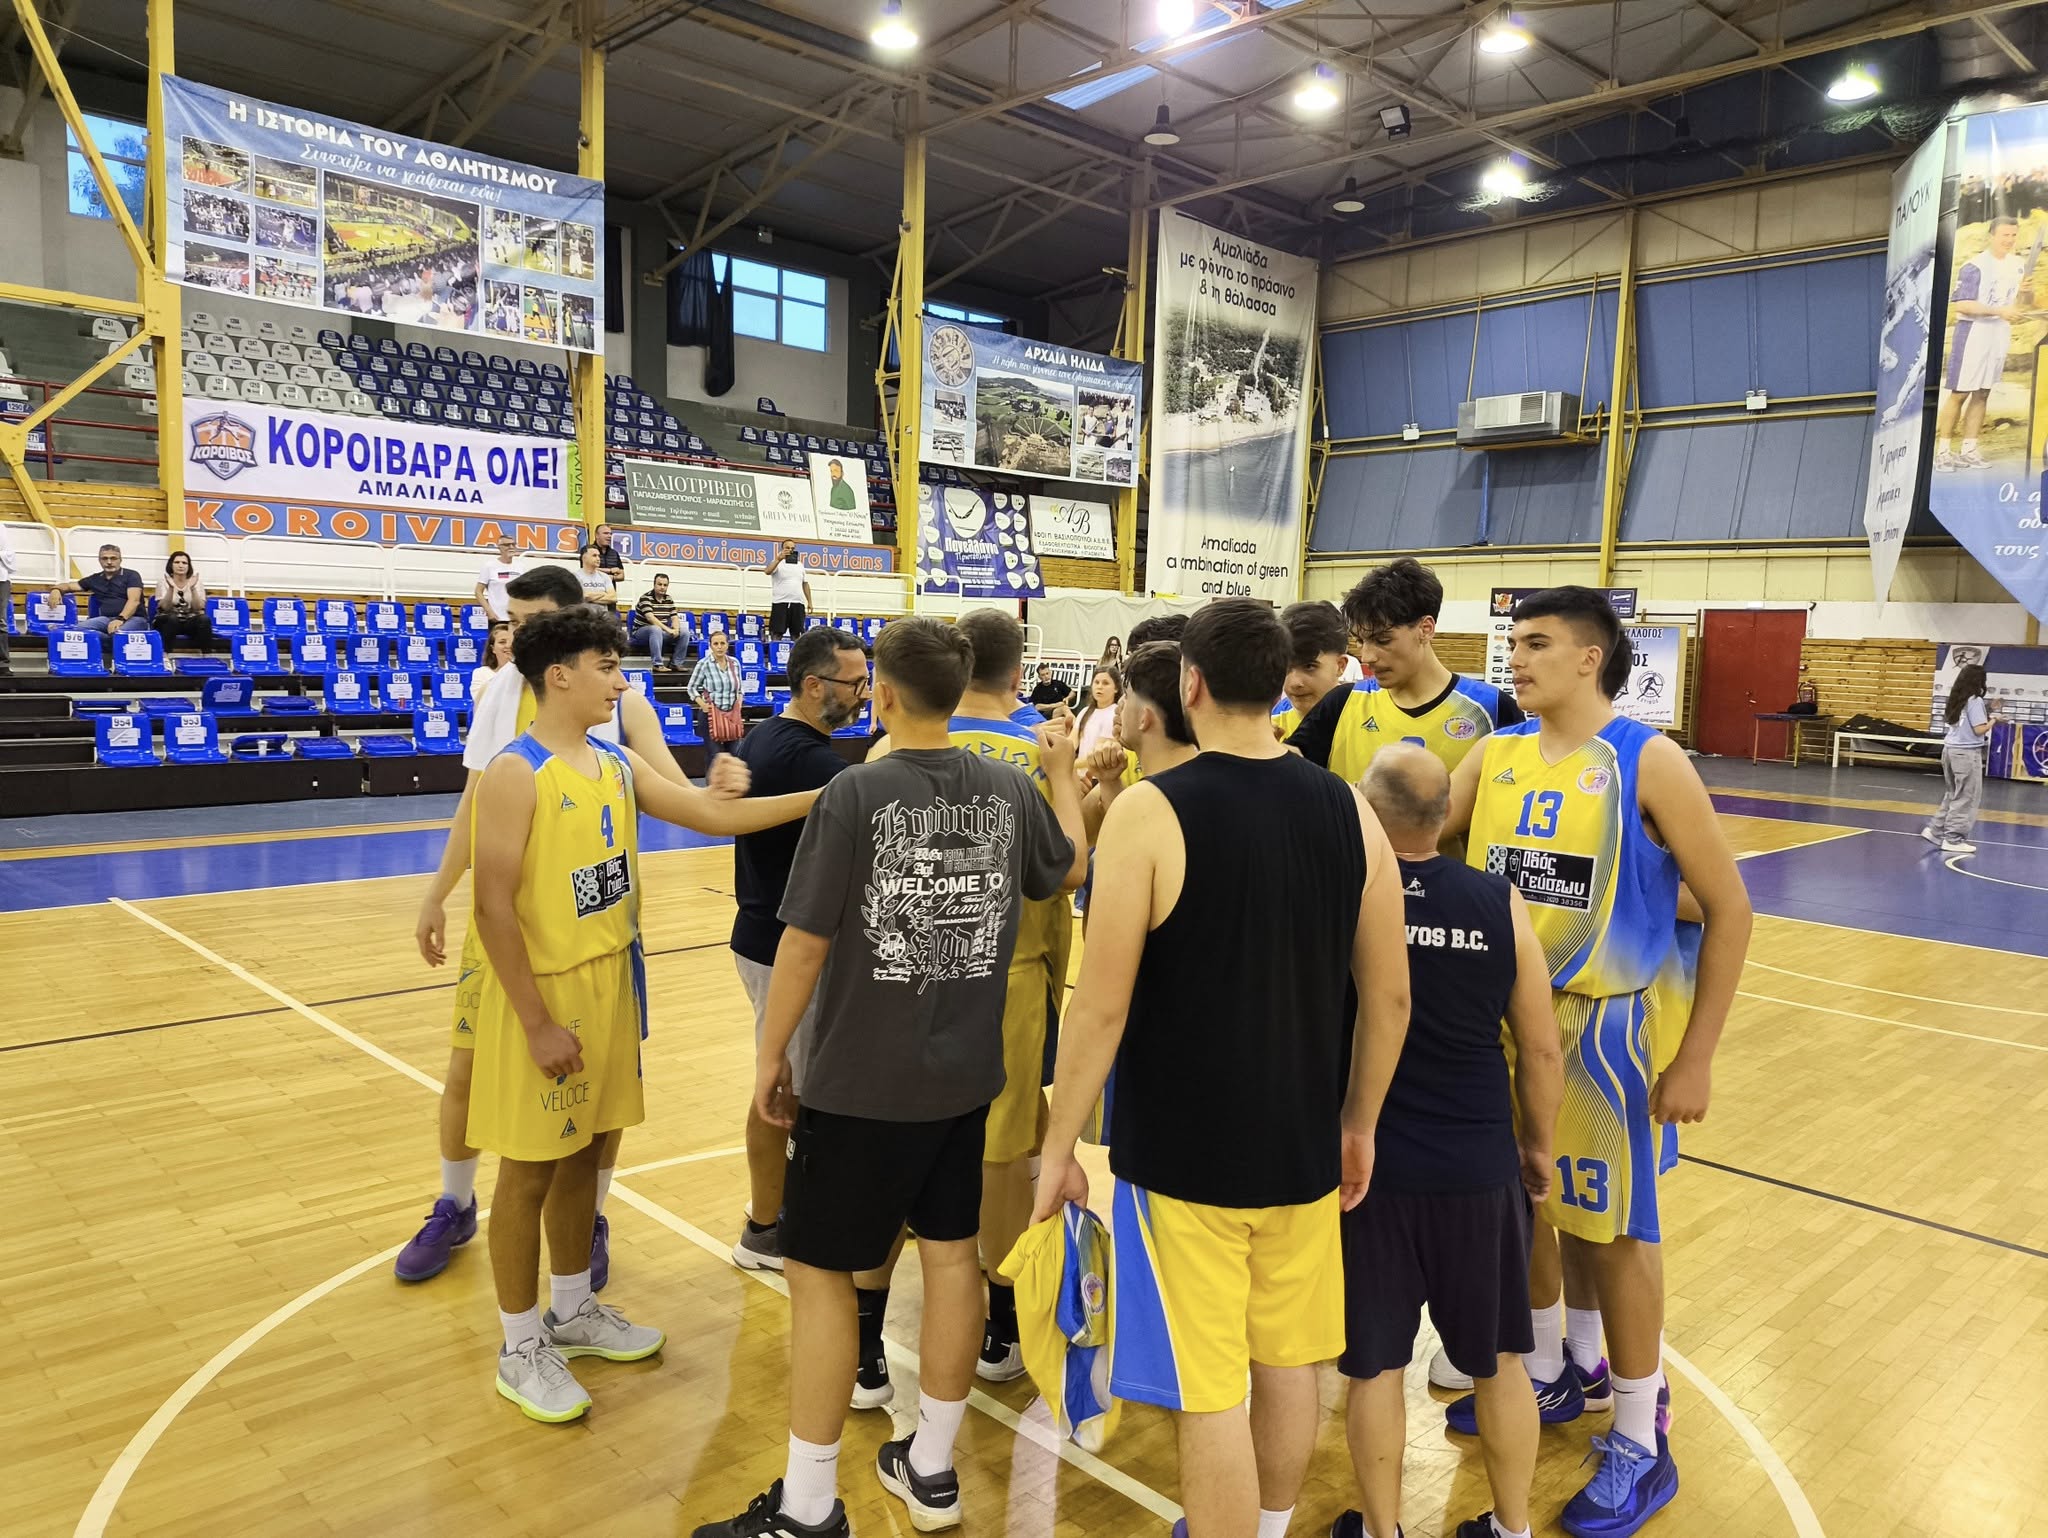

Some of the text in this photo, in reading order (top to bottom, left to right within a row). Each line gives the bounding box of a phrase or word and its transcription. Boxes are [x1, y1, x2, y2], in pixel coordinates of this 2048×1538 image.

[229, 101, 557, 195] Η ΙΣΤΟΡΙΑ ΤΟΥ ΑΘΛΗΤΙΣΜΟΥ
[1212, 236, 1268, 269] Αμαλιάδα
[1180, 252, 1295, 299] με φόντο το πράσινο
[1199, 279, 1277, 316] & τη θάλασσα
[1024, 345, 1106, 373] ΑΡΧΑΙΑ ΗΛΙΔΑ
[193, 446, 256, 464] ΚΟΡΟΙΒΟΣ
[268, 415, 559, 490] ΚΟΡΟΙΒΑΡΑ ΟΛΕ!
[358, 479, 484, 504] ΑΜΑΛΙΑΔΑ
[632, 471, 753, 499] ΕΛΑΙΟΤΡΙΒΕΙΟ
[184, 500, 580, 552] KOROIVIANS
[640, 533, 767, 565] koroivians
[773, 542, 883, 571] kroivians
[1201, 535, 1257, 554] Amaliada
[1994, 545, 2039, 559] τους
[1166, 556, 1177, 568] a
[1247, 562, 1258, 575] of
[1259, 564, 1288, 579] green
[1201, 580, 1251, 596] and blue
[1625, 628, 1663, 638] ΥΛΛΟΓΟΣ
[394, 674, 407, 682] 960
[114, 718, 131, 727] 954
[183, 717, 199, 725] 953
[600, 804, 615, 849] 4
[1515, 790, 1564, 839] 13
[1522, 850, 1557, 876] Οδός
[1519, 870, 1585, 896] Γεύσεων
[1451, 928, 1489, 951] B.C.
[540, 1081, 590, 1112] VELOCE
[1555, 1154, 1610, 1215] 13
